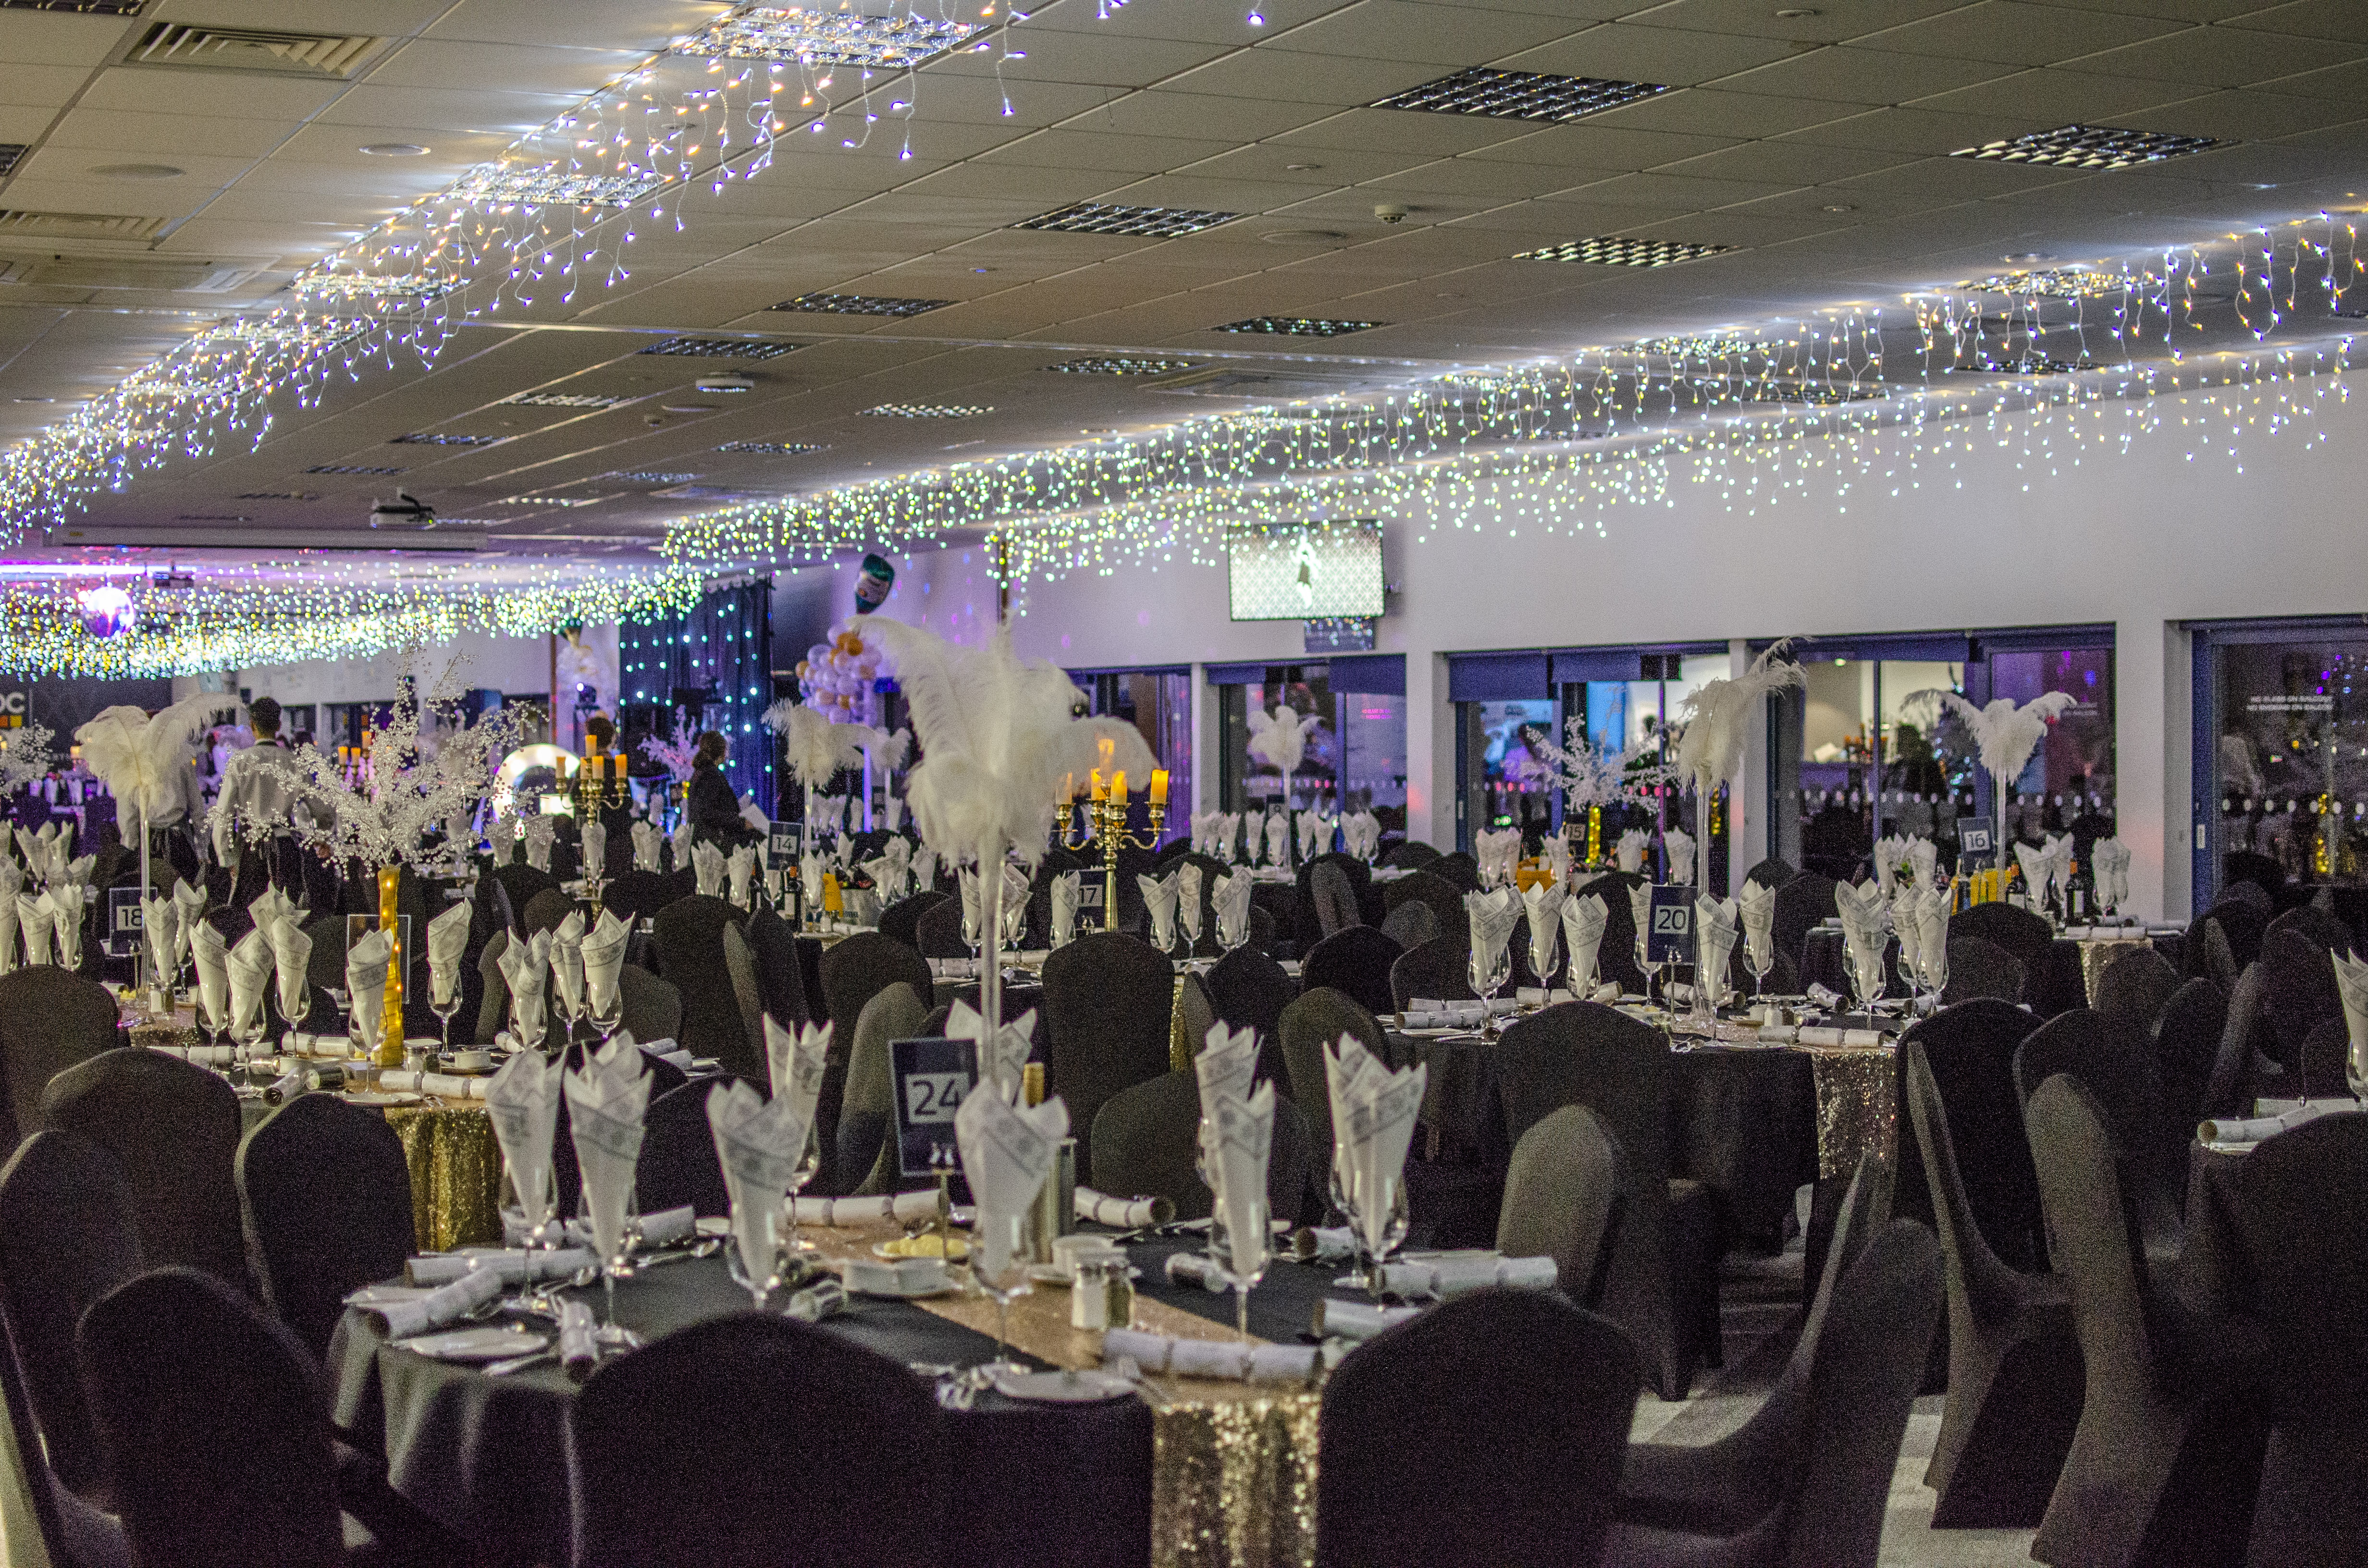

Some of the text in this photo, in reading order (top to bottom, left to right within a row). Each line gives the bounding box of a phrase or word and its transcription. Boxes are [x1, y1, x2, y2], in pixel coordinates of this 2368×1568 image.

[776, 836, 793, 851] 14
[1969, 833, 1986, 848] 16
[1079, 887, 1097, 904] 17
[122, 908, 143, 927] 18
[1658, 908, 1686, 930] 20
[913, 1079, 961, 1116] 24
